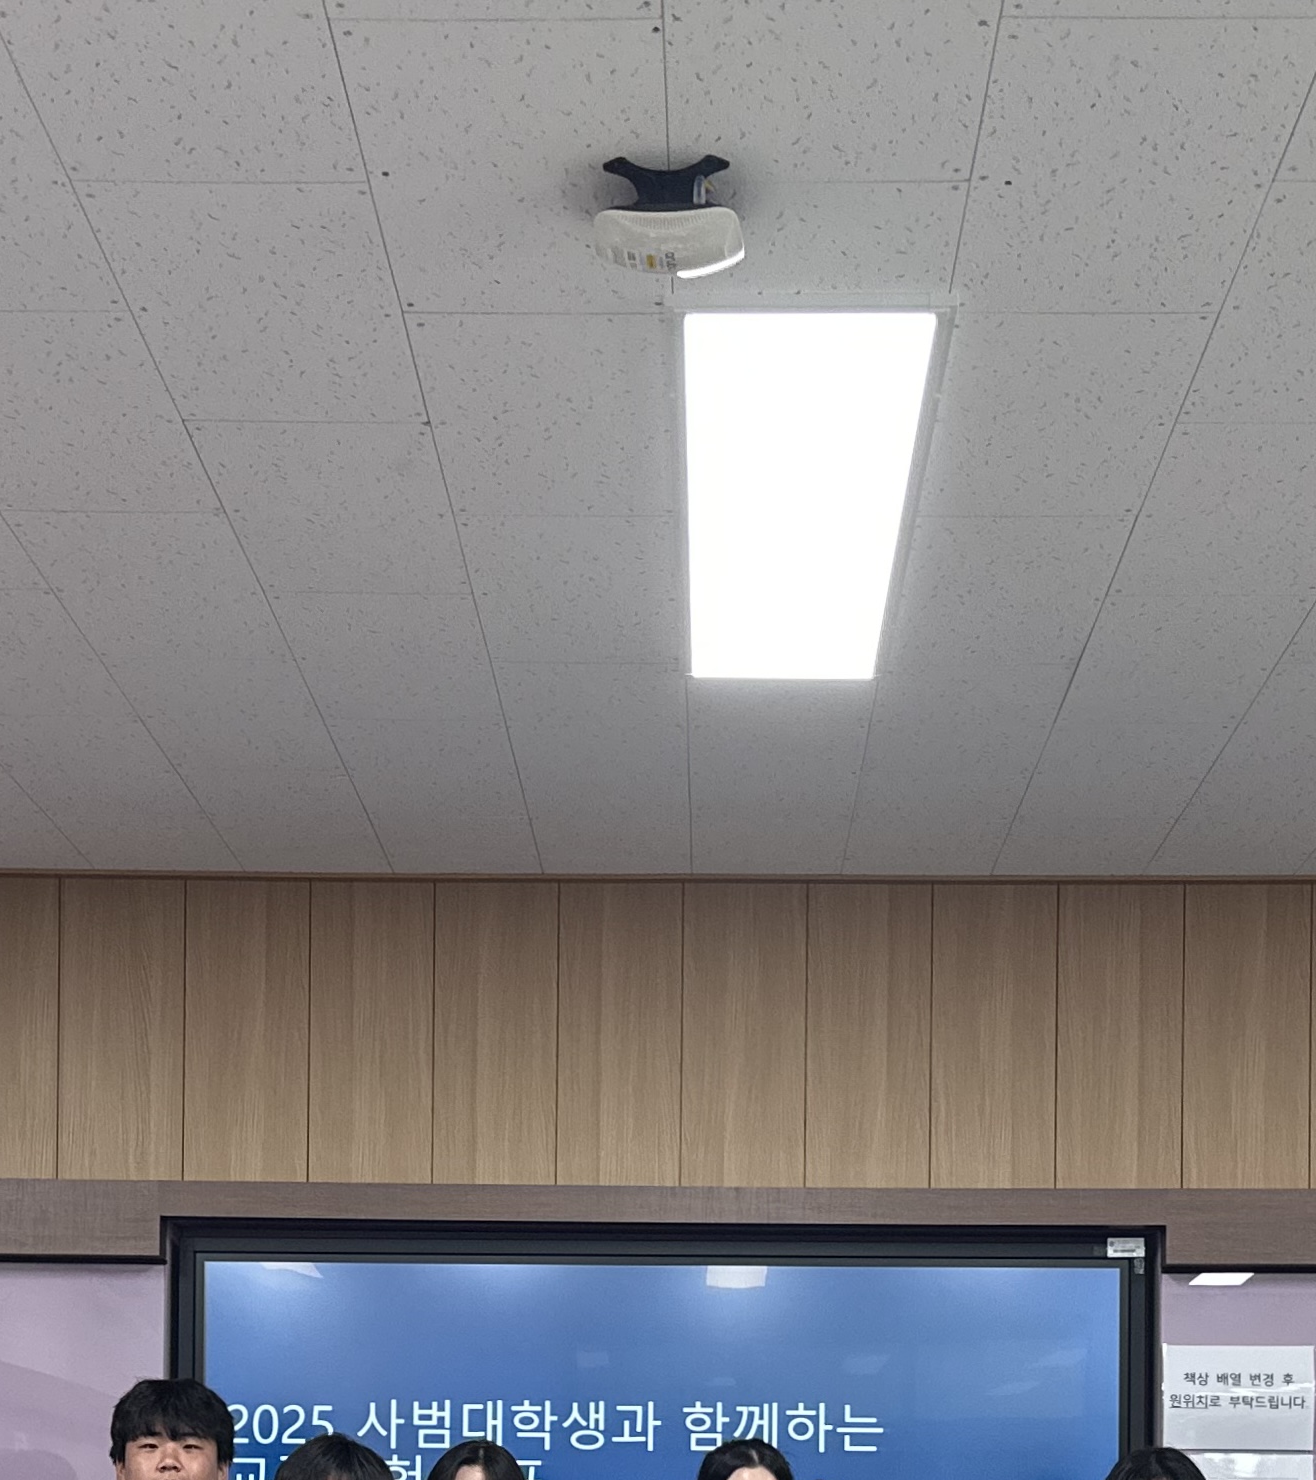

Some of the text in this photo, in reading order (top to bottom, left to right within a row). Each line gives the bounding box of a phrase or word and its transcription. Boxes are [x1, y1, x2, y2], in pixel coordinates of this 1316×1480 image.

[1183, 1372, 1295, 1387] 책상 배열 변경 후
[1169, 1394, 1221, 1408] 원위치로
[226, 1398, 884, 1453] 2025 사범대학생과 함께하는
